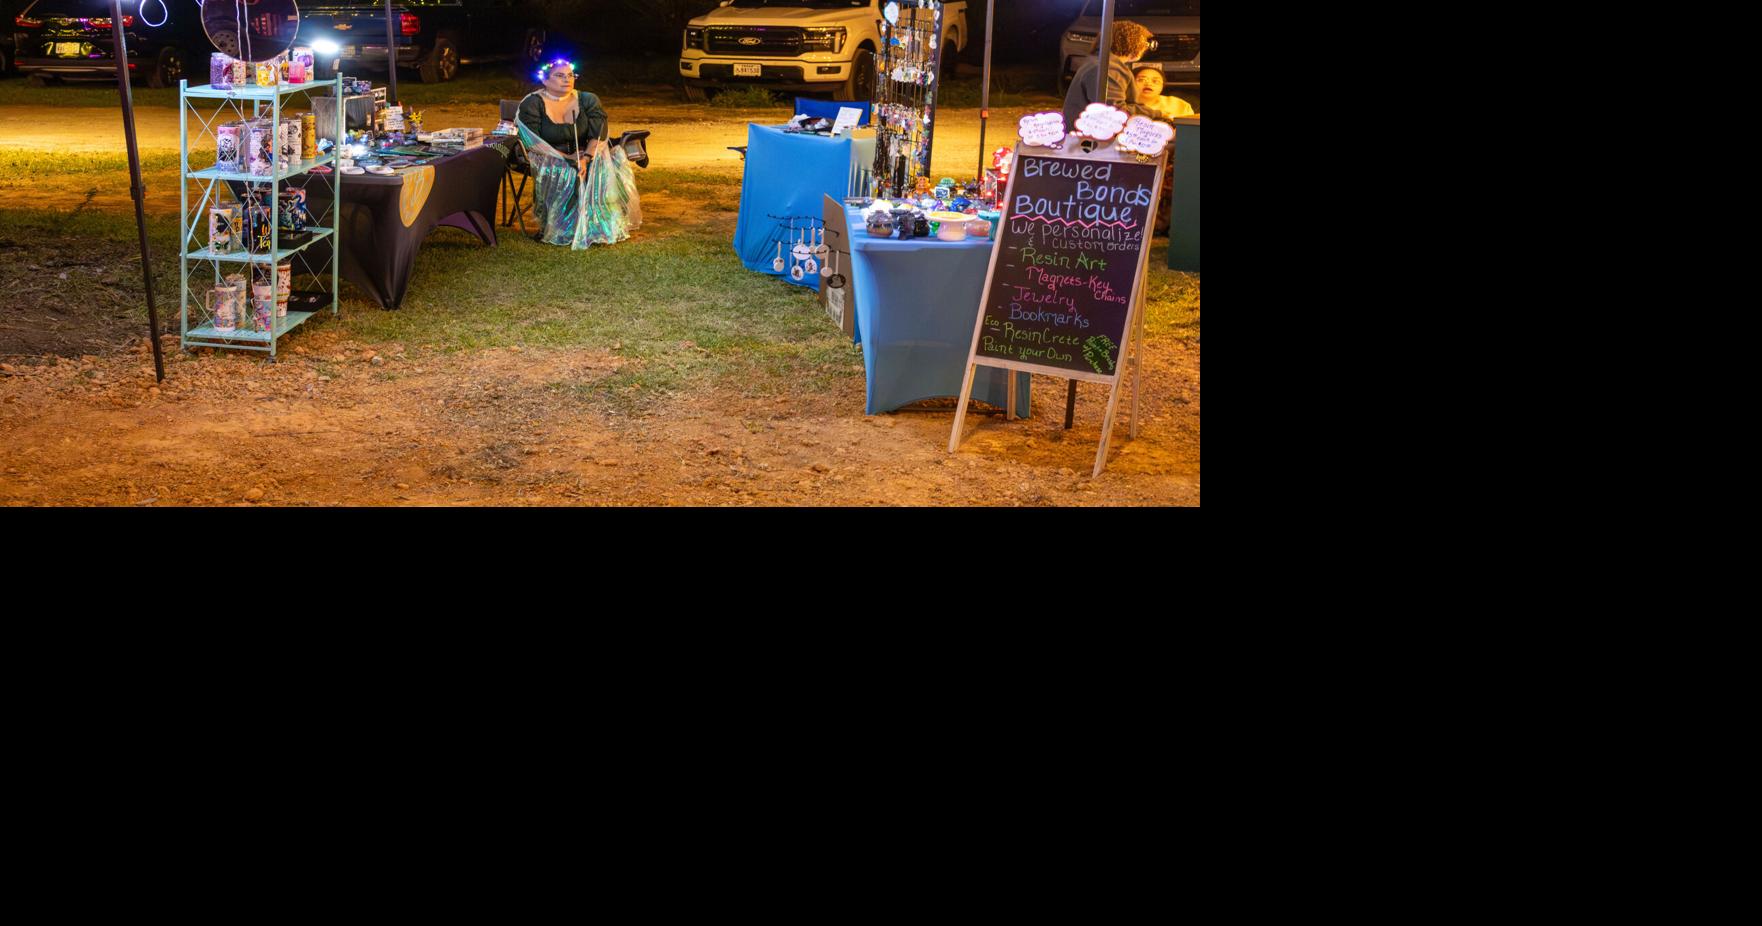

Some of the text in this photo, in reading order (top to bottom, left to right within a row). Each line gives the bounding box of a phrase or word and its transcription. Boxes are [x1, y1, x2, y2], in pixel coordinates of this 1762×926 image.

[1024, 158, 1112, 181] Brewed
[1076, 180, 1152, 206] Bonds
[1015, 194, 1132, 226] Boutique
[1011, 220, 1035, 235] We
[1020, 246, 1108, 271] Resin Art
[1106, 240, 1140, 252] orders
[1012, 285, 1076, 313] Jewelry
[985, 315, 999, 326] Eco
[1008, 302, 1090, 328] Bookmarks
[982, 335, 1073, 362] Paint your Own
